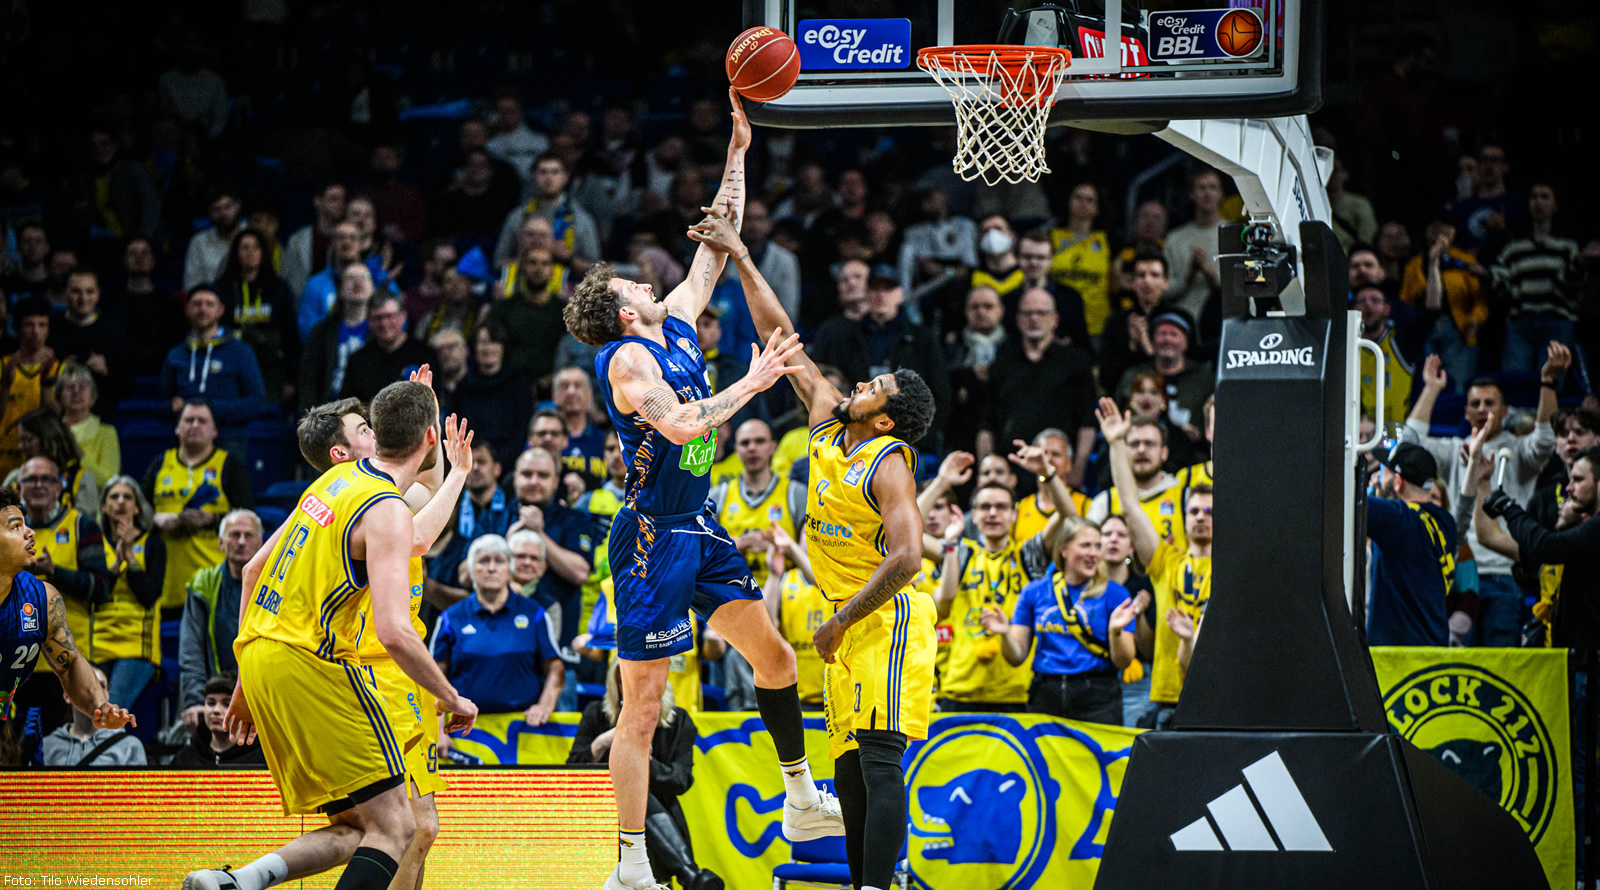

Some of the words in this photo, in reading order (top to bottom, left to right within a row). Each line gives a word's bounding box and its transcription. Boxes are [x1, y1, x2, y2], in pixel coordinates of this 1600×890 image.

[1171, 24, 1205, 35] Credit
[729, 27, 775, 64] SPALDING
[833, 44, 904, 64] Credit
[1157, 35, 1205, 56] BBL
[1226, 346, 1315, 369] SPALDING
[684, 438, 717, 466] Karl
[1386, 675, 1482, 735] LOCK
[1490, 695, 1541, 759] 212
[427, 742, 437, 774] 9
